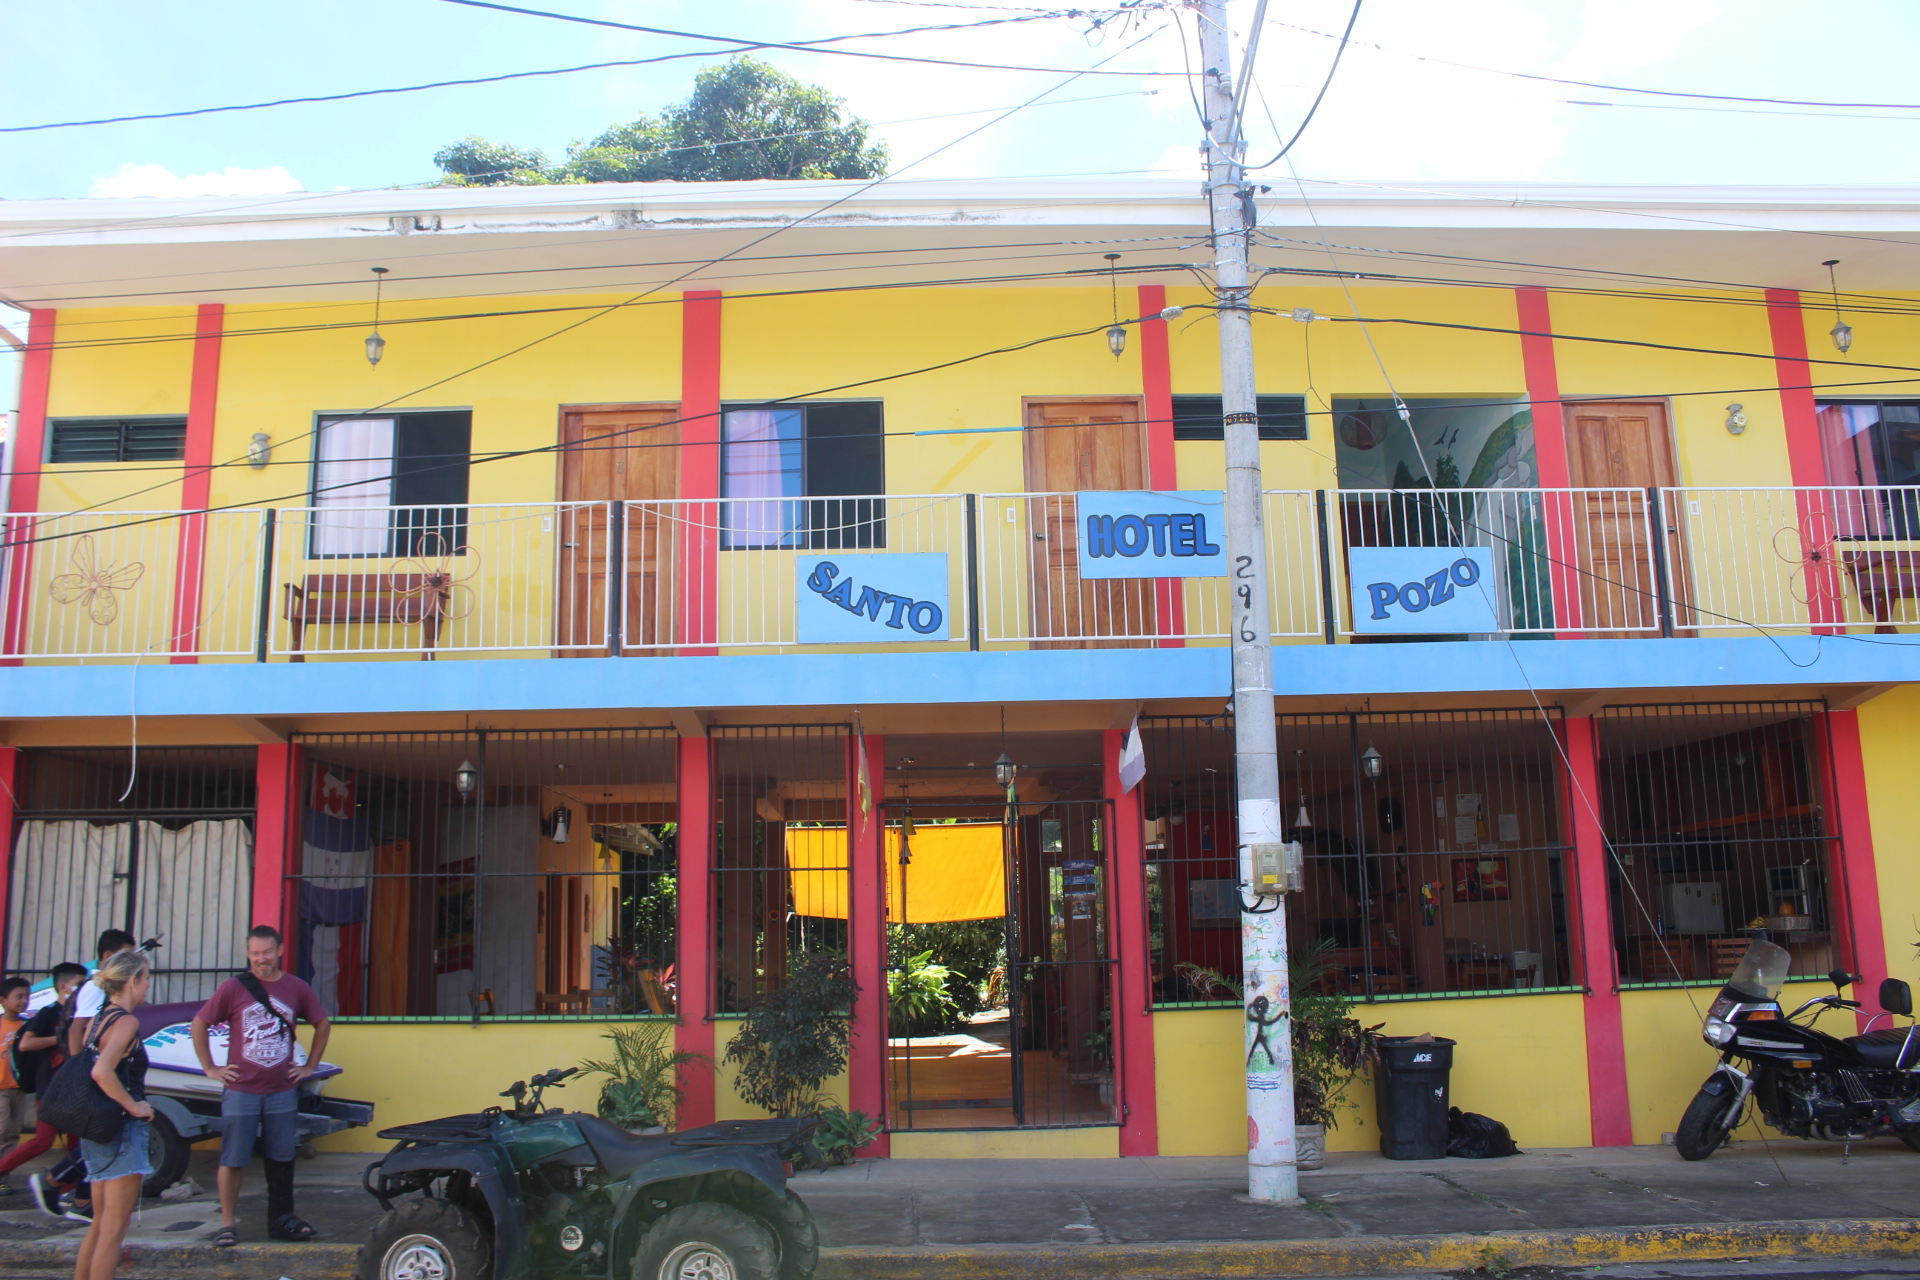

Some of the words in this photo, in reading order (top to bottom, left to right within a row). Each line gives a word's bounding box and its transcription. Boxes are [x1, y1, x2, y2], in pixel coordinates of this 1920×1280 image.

[1086, 513, 1221, 558] HOTEL
[806, 561, 943, 634] SANTO
[1236, 556, 1256, 643] 296
[1366, 557, 1480, 620] POZO
[244, 1016, 288, 1049] Fend
[1412, 1053, 1433, 1063] ACE
